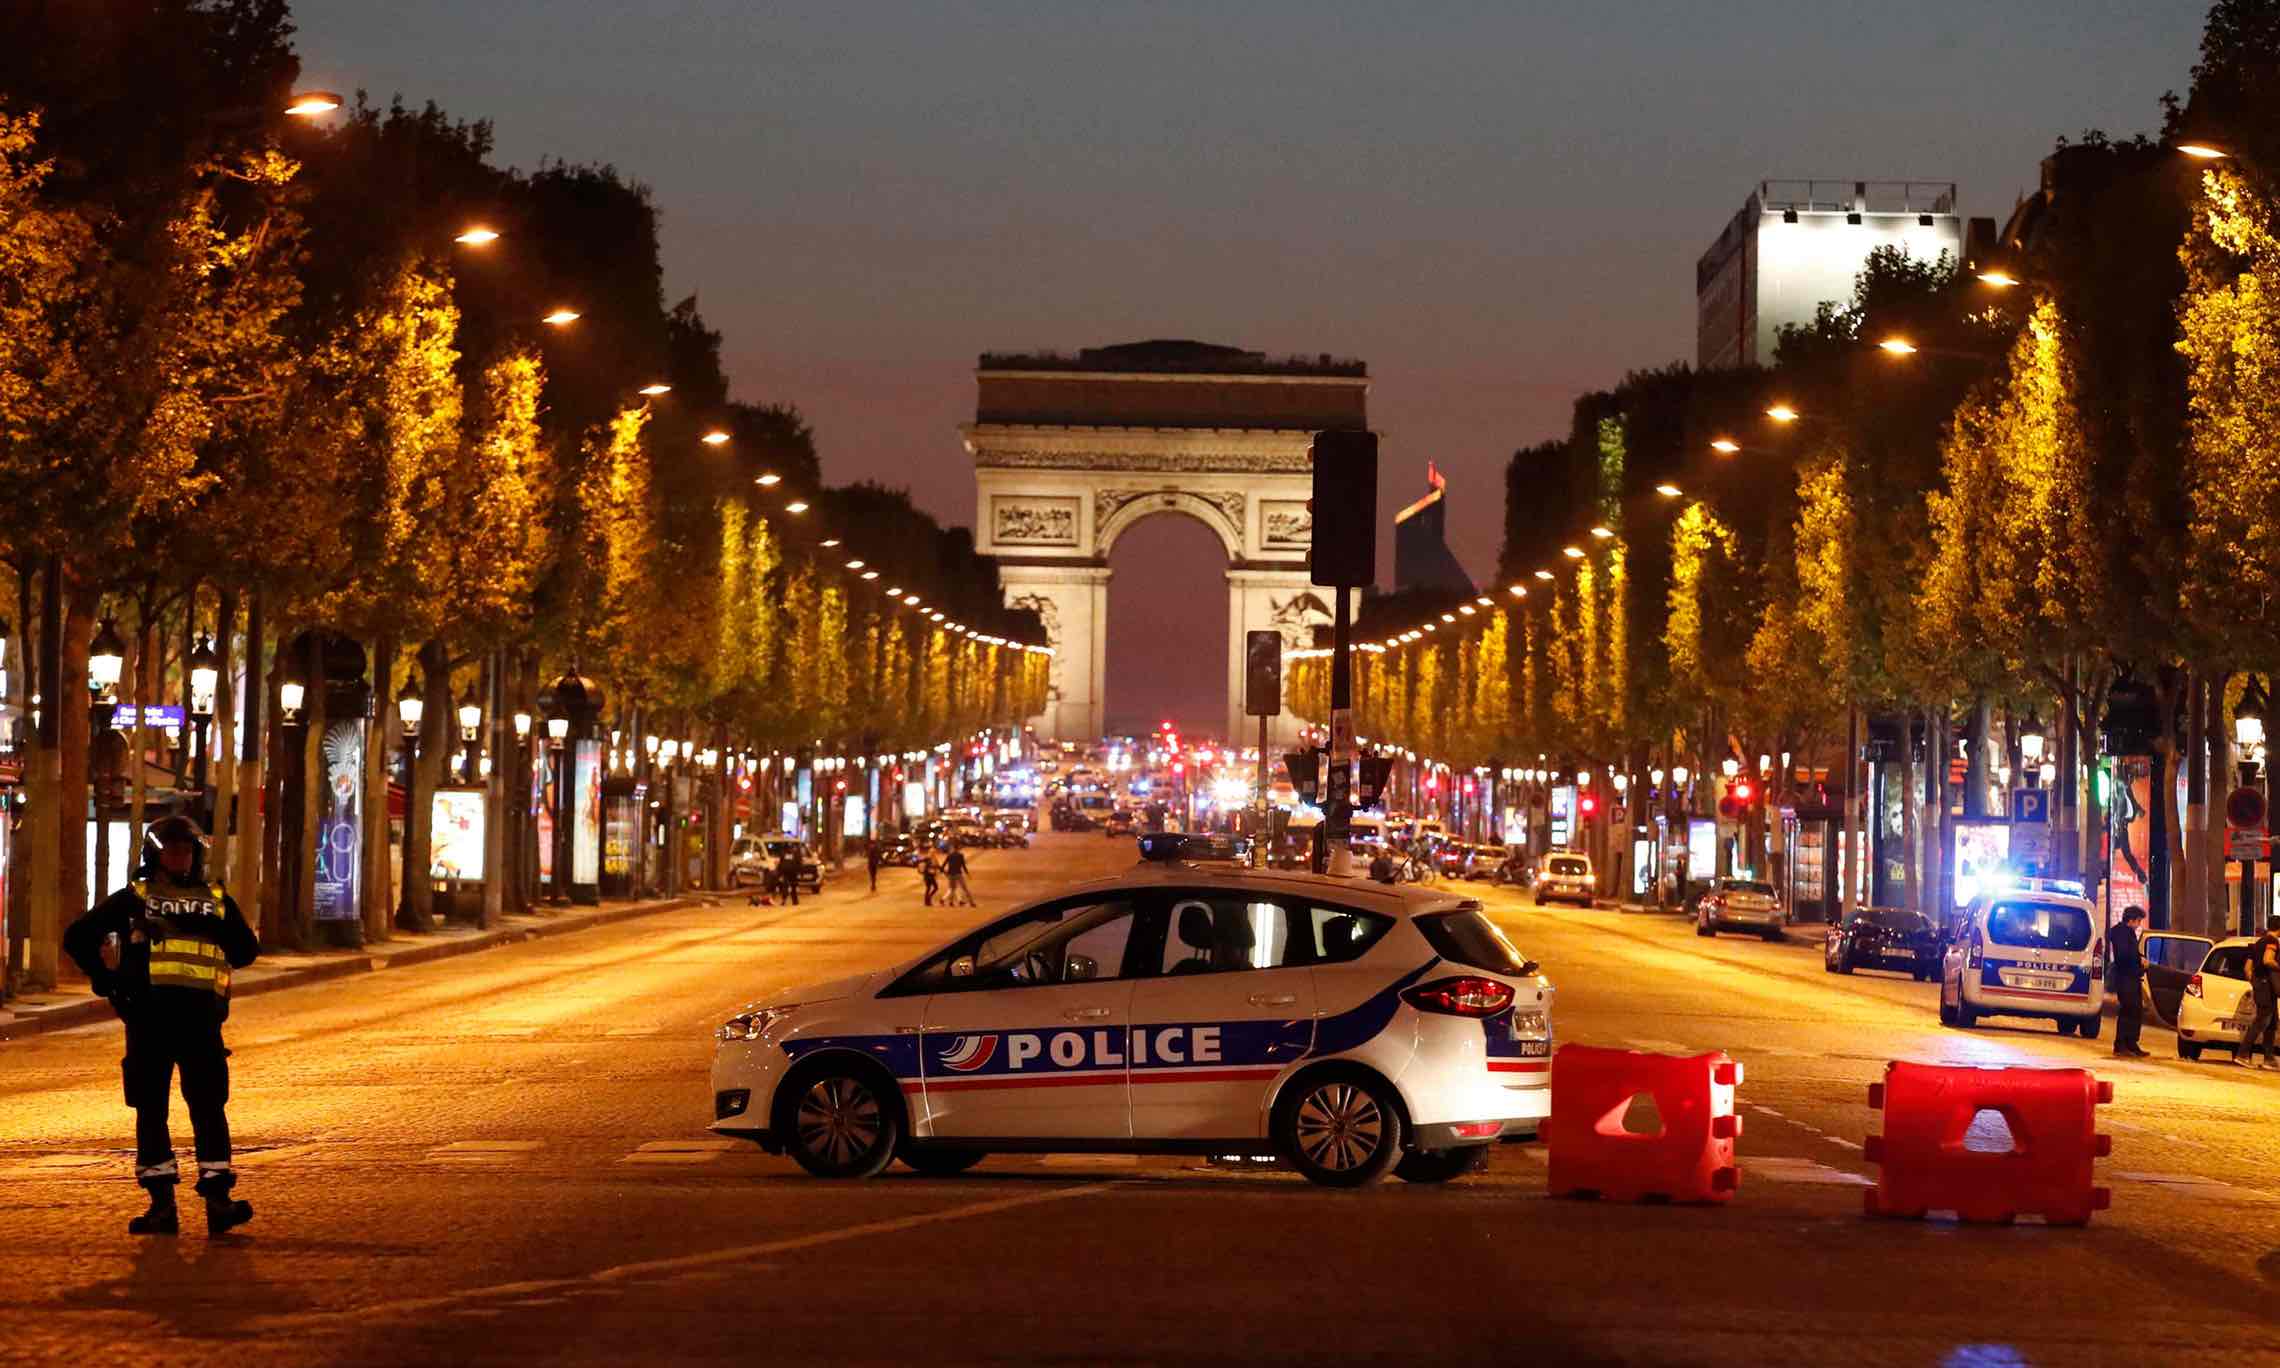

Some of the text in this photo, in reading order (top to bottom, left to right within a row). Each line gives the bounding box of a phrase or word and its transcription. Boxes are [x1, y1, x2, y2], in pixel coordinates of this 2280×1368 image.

[2024, 795, 2038, 818] P
[2016, 961, 2058, 971] POLICE
[1008, 1027, 1222, 1069] POLICE
